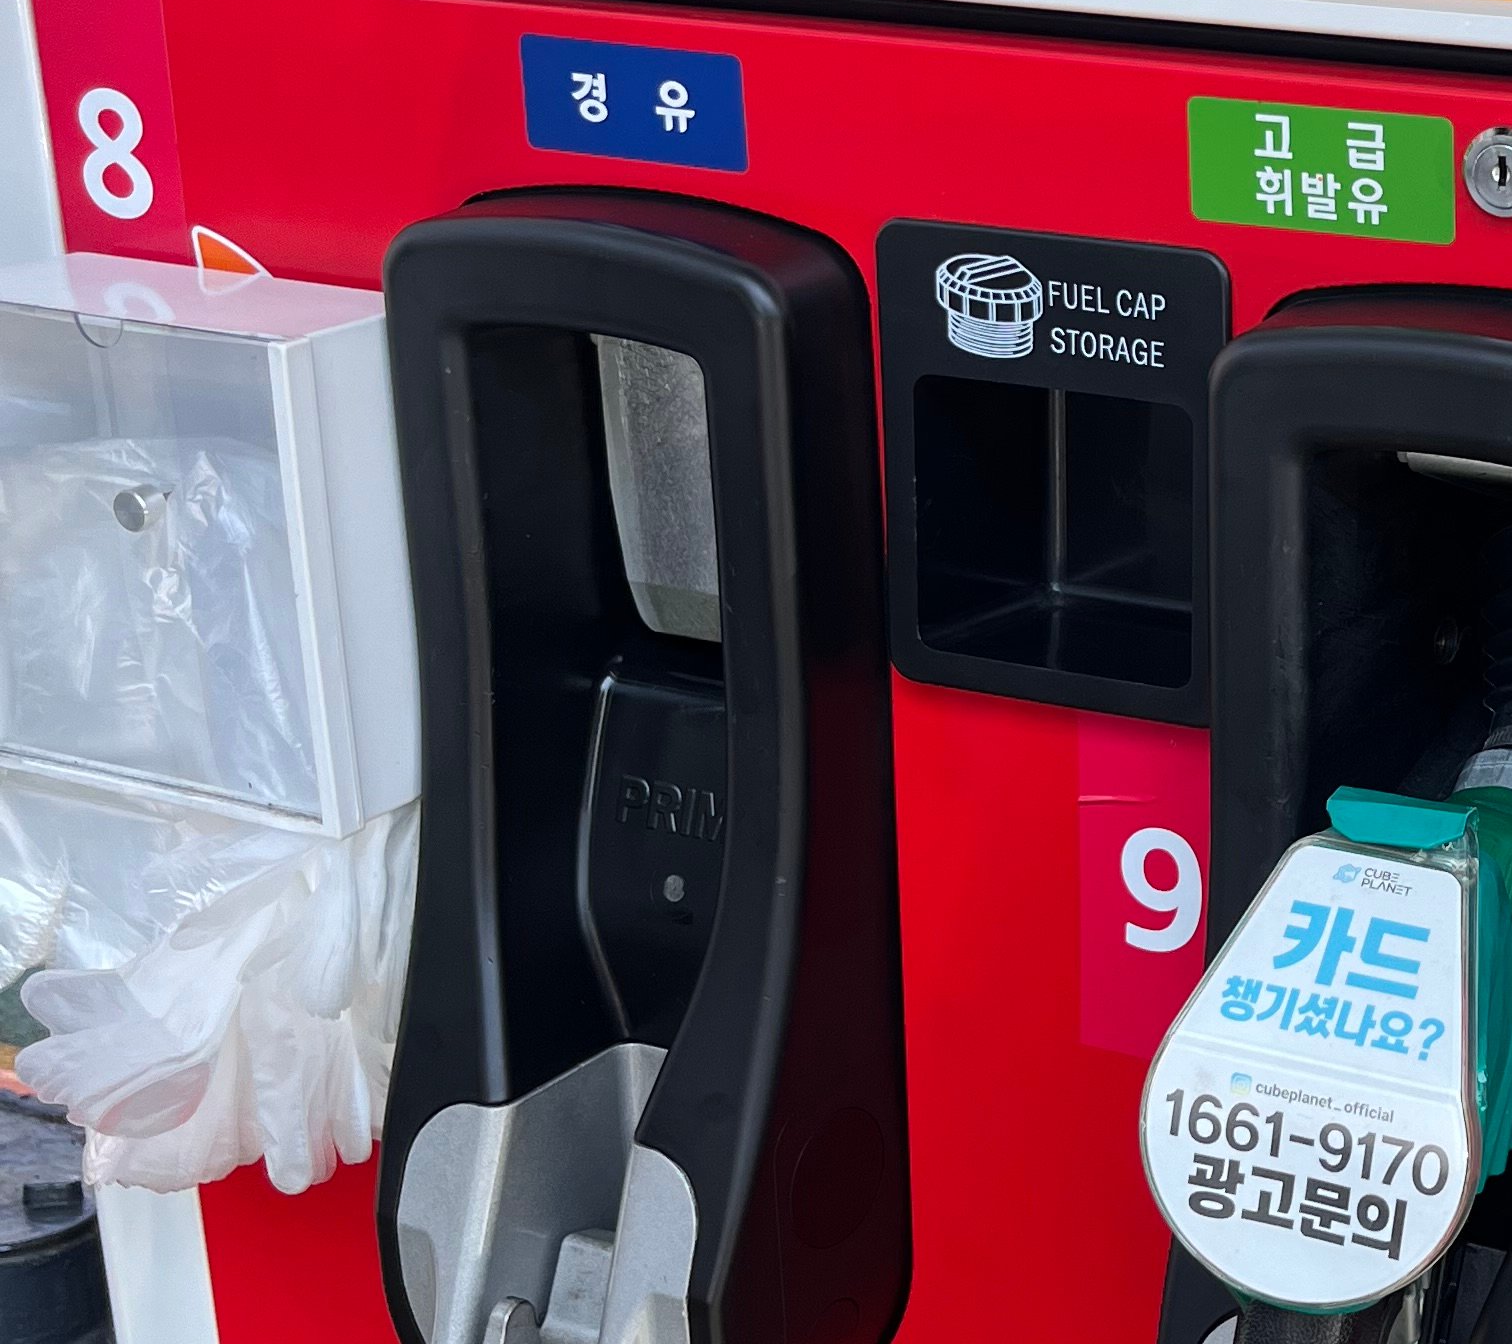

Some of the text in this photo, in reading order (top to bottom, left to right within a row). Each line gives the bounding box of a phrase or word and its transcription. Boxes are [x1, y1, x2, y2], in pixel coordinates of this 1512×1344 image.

[78, 87, 154, 219] 8
[1255, 165, 1388, 226] 휘발유
[1048, 280, 1166, 321] FUEL CAP
[1050, 327, 1166, 369] STORAGE
[1120, 827, 1203, 953] 9
[1360, 878, 1413, 897] PLANET
[1364, 867, 1401, 883] CUBE
[1272, 899, 1431, 1000] 카드
[1220, 974, 1446, 1062] 챙기셨나요?
[1165, 1087, 1450, 1197] 1661-9170
[1187, 1152, 1408, 1261] 광고문의
